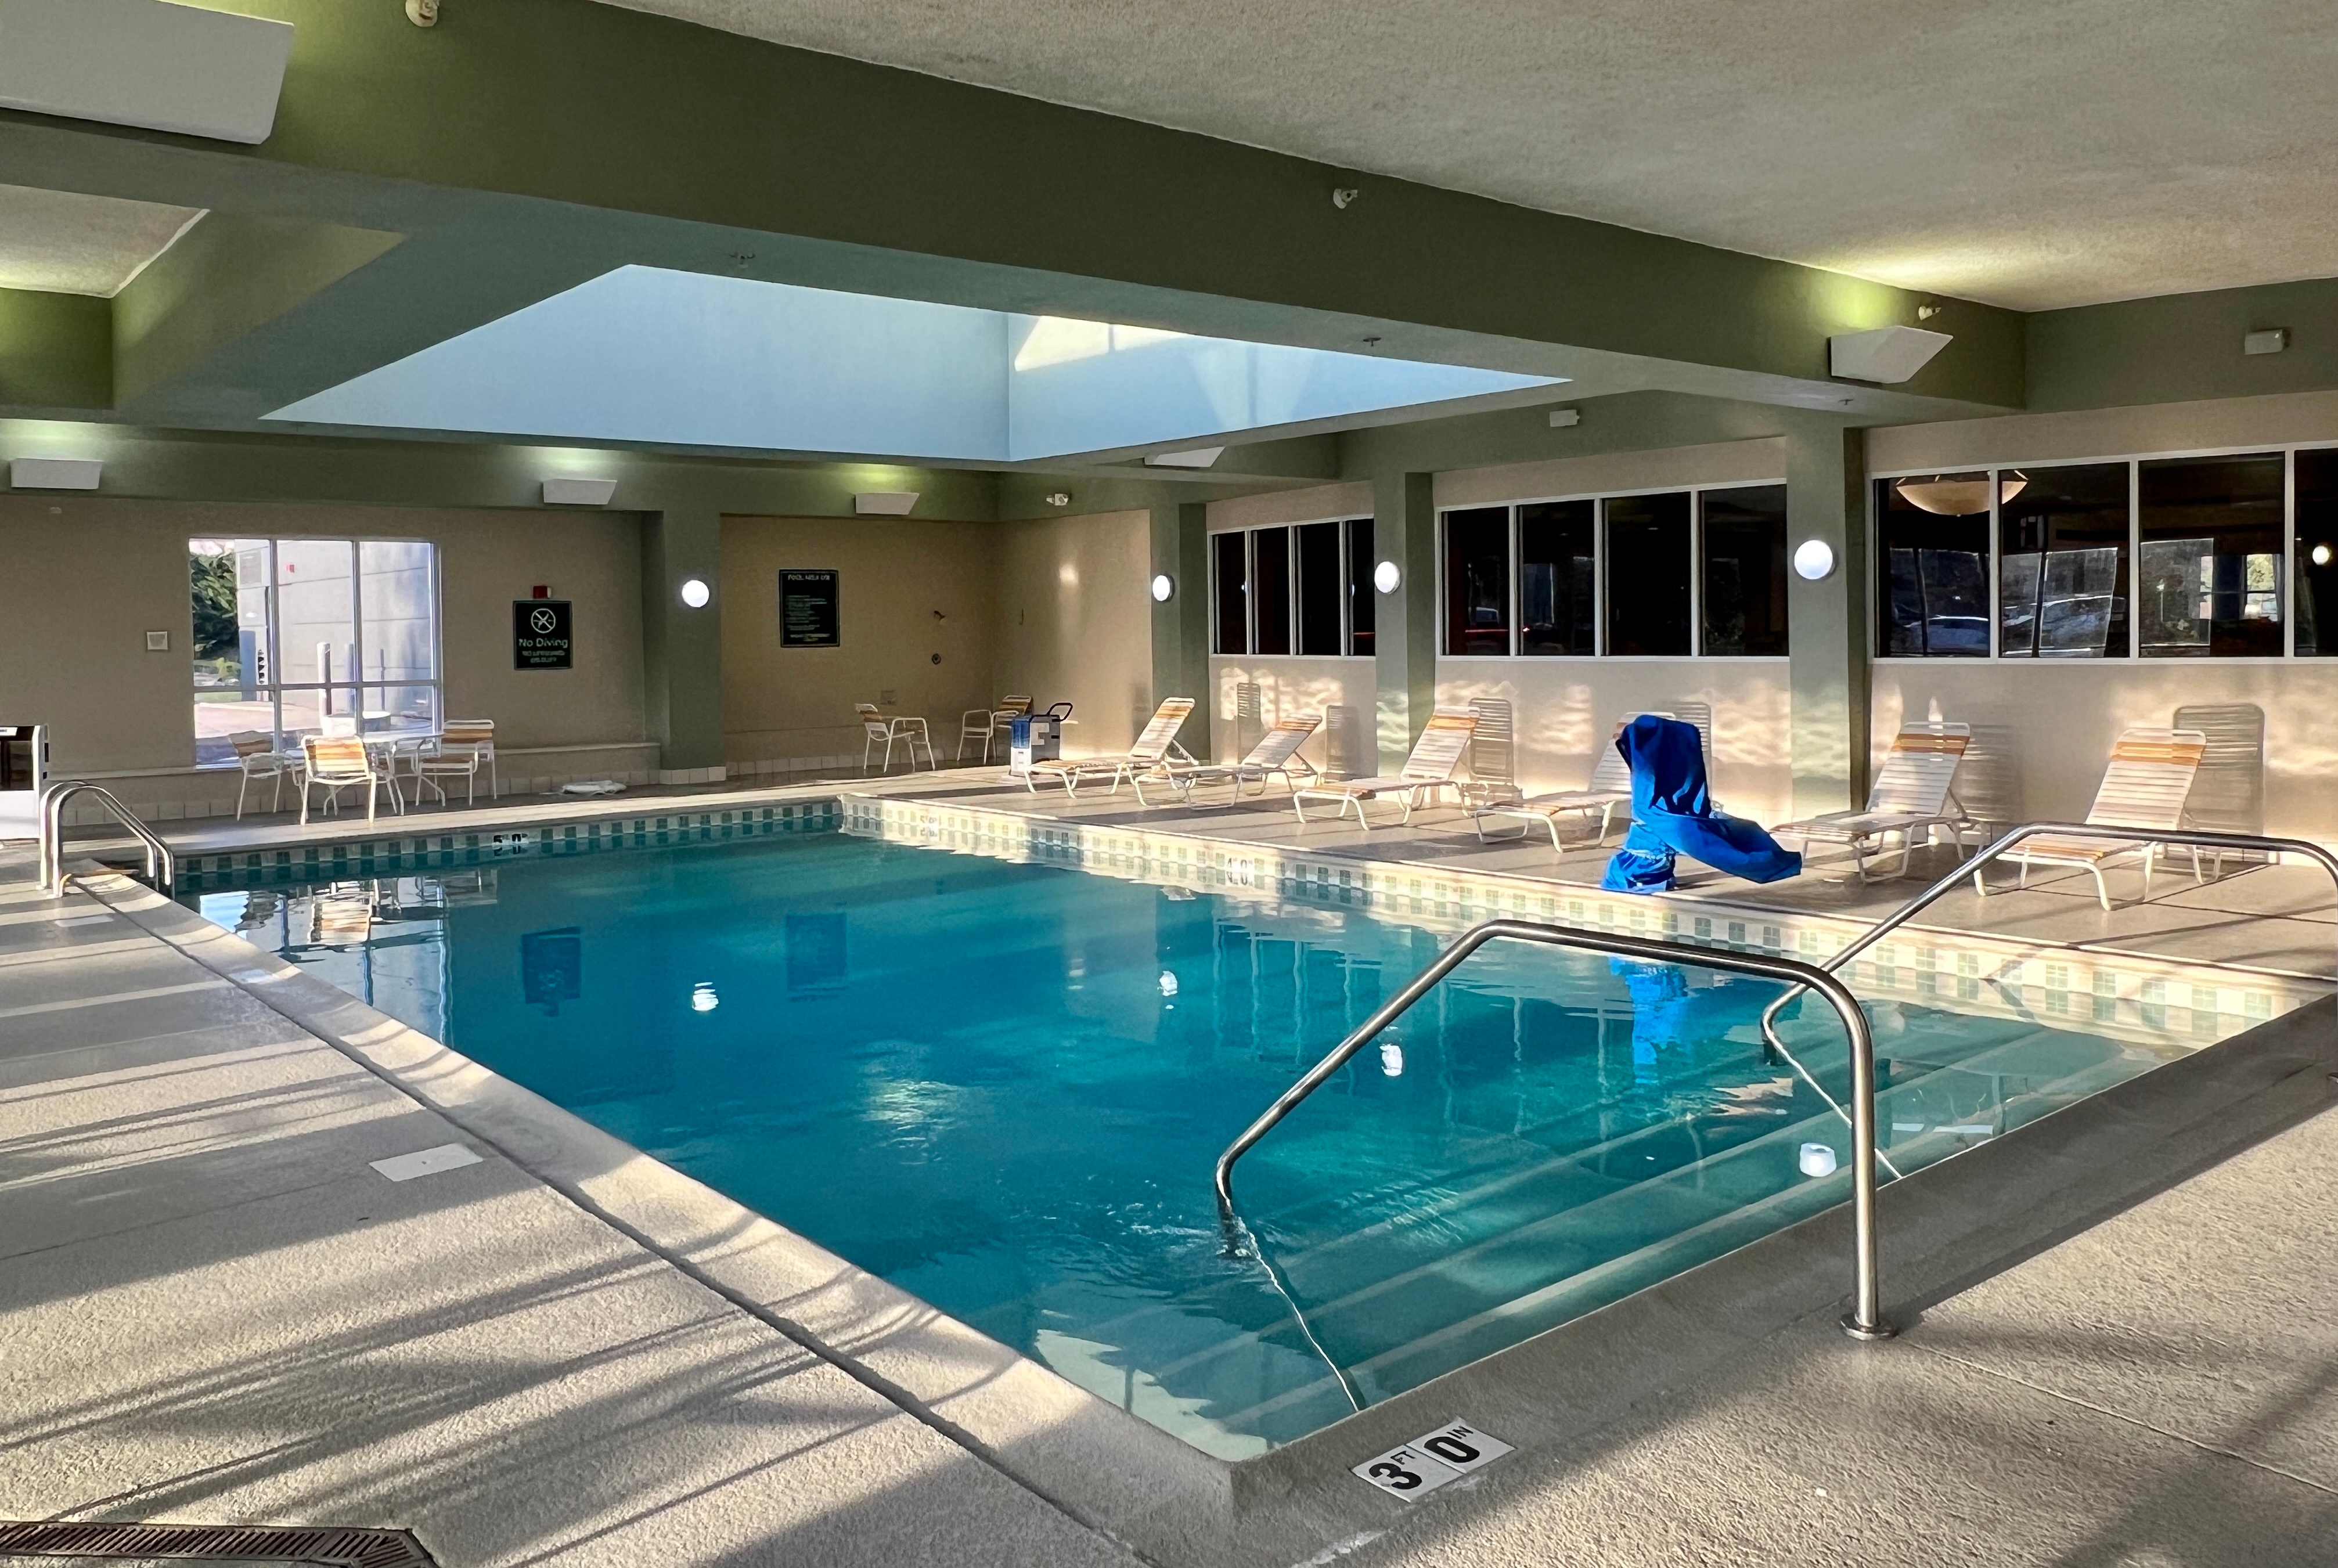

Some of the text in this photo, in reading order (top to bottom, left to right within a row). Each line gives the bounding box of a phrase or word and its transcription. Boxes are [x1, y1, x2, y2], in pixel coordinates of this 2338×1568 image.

[518, 637, 568, 648] No Diving
[1368, 1425, 1480, 1490] 3 FT 0 IN
